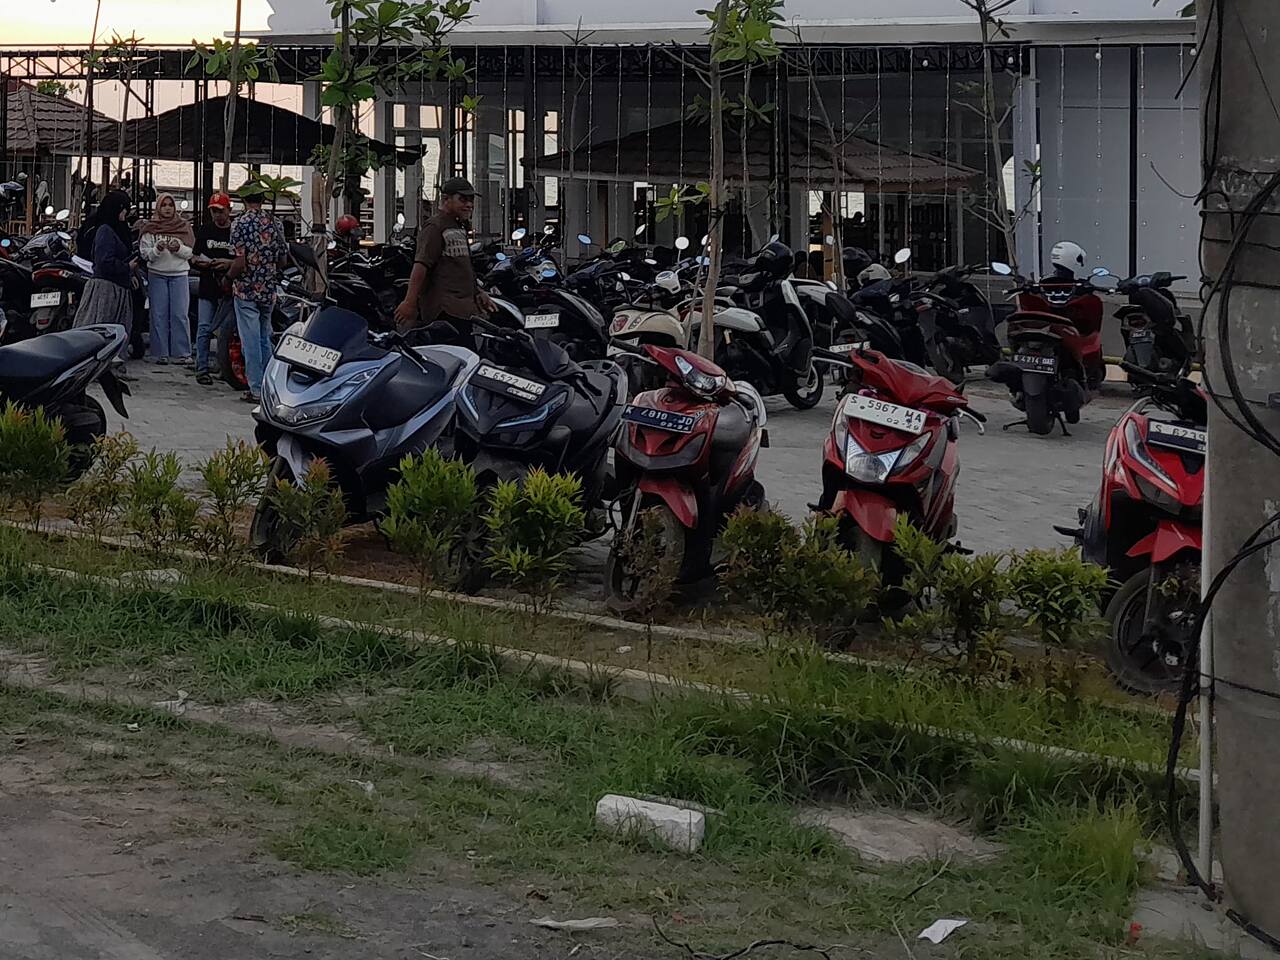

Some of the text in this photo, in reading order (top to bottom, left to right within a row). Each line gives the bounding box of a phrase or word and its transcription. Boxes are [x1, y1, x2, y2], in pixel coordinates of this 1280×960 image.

[294, 340, 318, 354] 3931
[850, 395, 858, 404] S
[867, 400, 898, 414] 5967
[677, 416, 693, 425] JD
